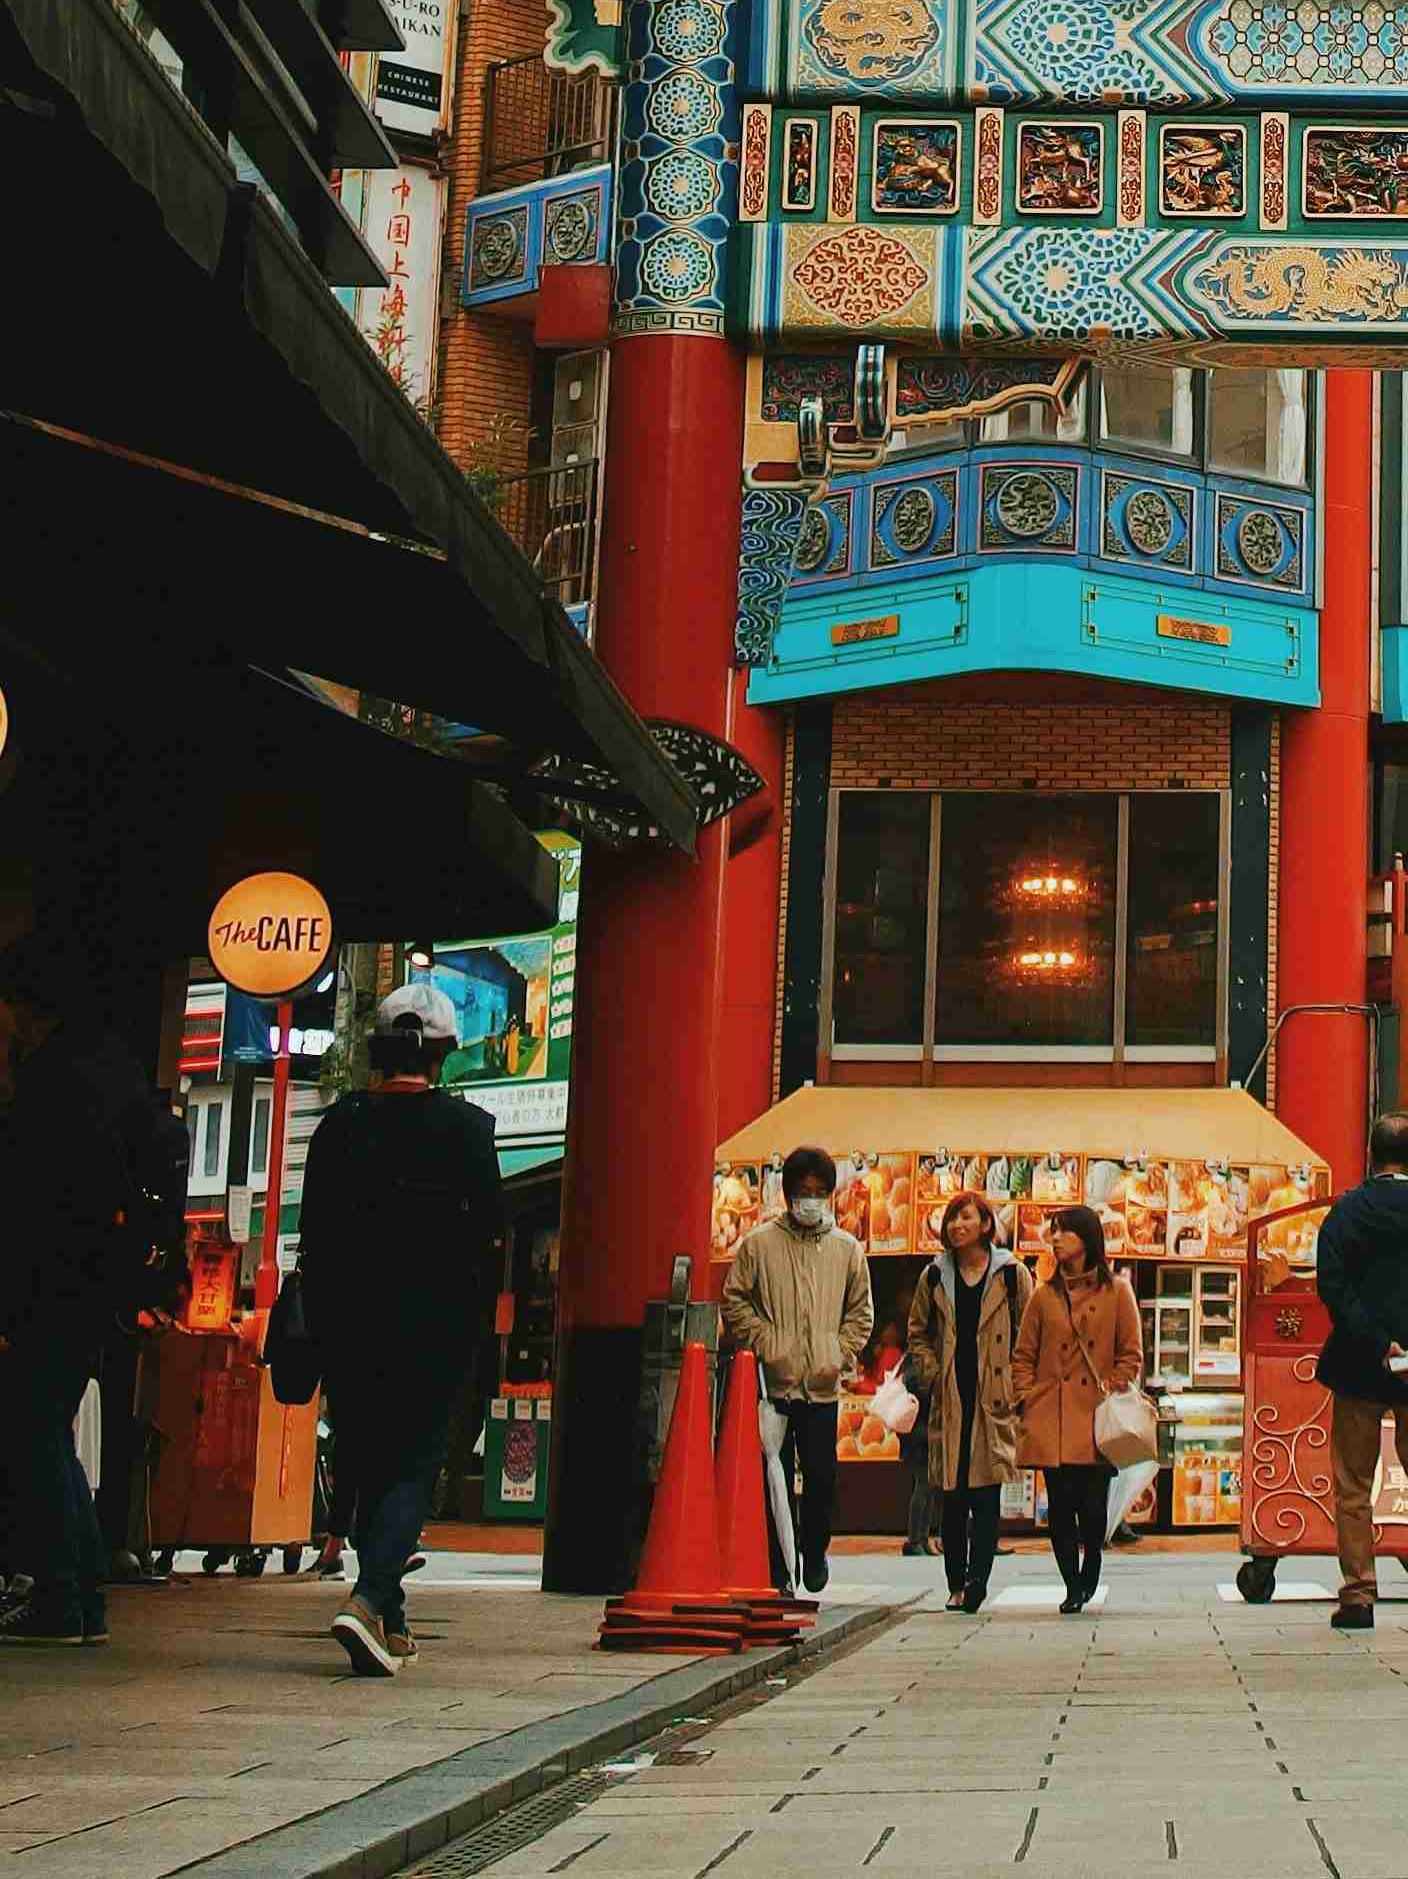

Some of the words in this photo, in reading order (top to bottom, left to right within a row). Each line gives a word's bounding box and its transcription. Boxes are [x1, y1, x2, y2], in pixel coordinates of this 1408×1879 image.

[391, 15, 442, 38] AIKAN
[387, 70, 431, 88] CHINESE
[215, 921, 257, 947] The
[256, 915, 324, 953] CAFE
